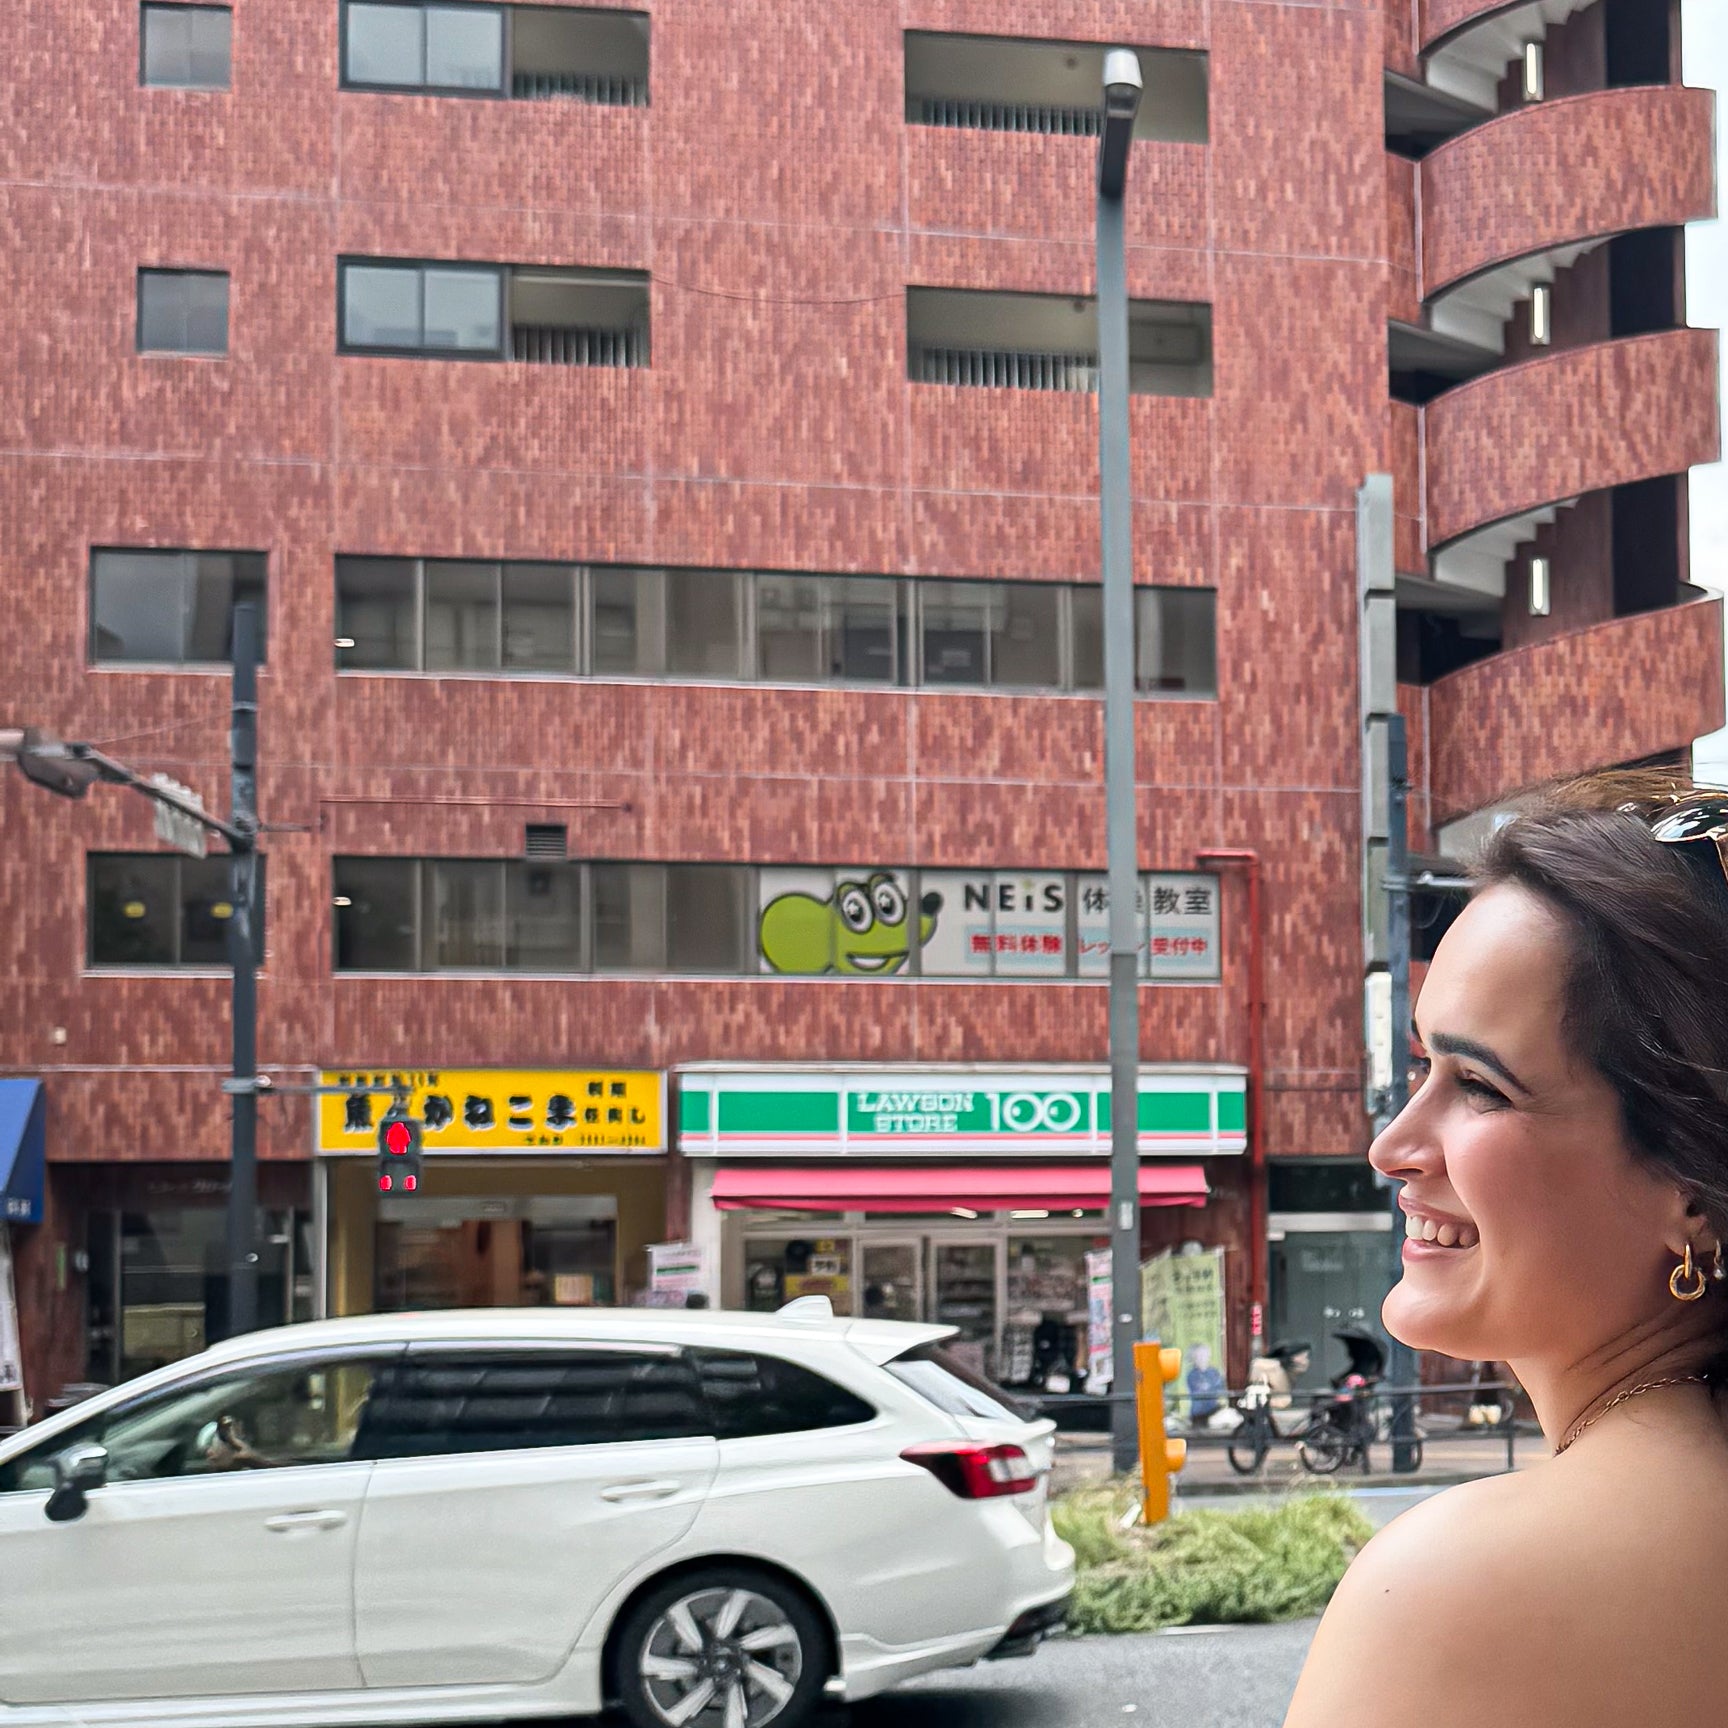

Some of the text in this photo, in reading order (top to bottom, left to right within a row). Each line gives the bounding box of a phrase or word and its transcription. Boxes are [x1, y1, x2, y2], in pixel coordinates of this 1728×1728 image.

[963, 880, 1212, 916] NEiS 体教室
[857, 1092, 974, 1112] LAWSON
[985, 1092, 1081, 1132] 100
[874, 1113, 958, 1132] STORE
